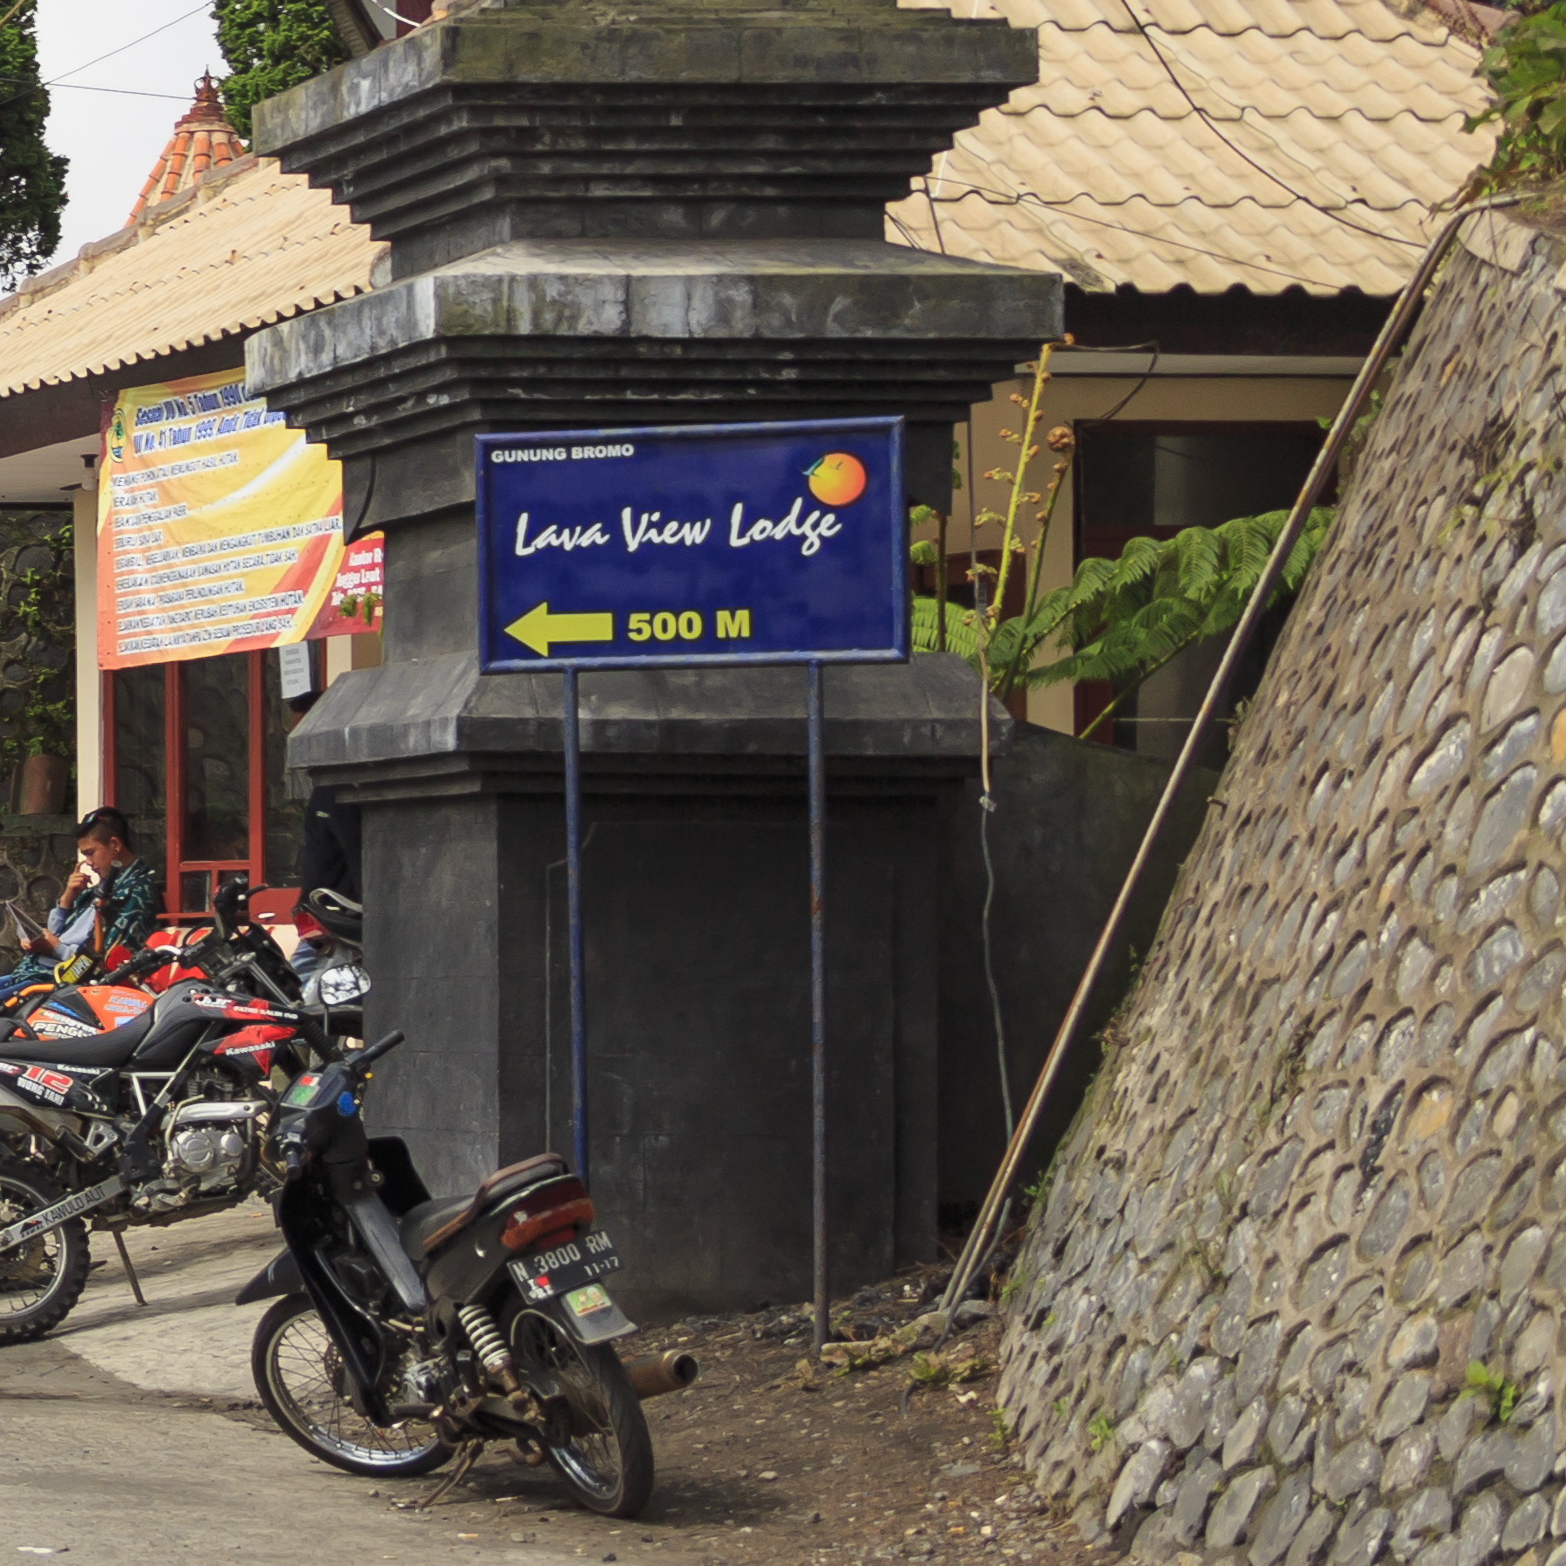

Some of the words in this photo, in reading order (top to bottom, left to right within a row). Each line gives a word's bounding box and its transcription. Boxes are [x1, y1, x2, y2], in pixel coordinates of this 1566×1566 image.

[490, 446, 567, 464] GUNUNG
[570, 443, 635, 461] BROMO
[515, 511, 611, 556] Lava
[620, 506, 712, 553] View
[728, 496, 843, 557] Lodge
[627, 610, 703, 642] 500
[715, 609, 751, 638] M
[225, 1040, 276, 1056] Kawasaki
[23, 1065, 74, 1095] 12
[511, 1261, 530, 1283] N
[533, 1242, 582, 1276] 3800
[584, 1230, 613, 1255] RM
